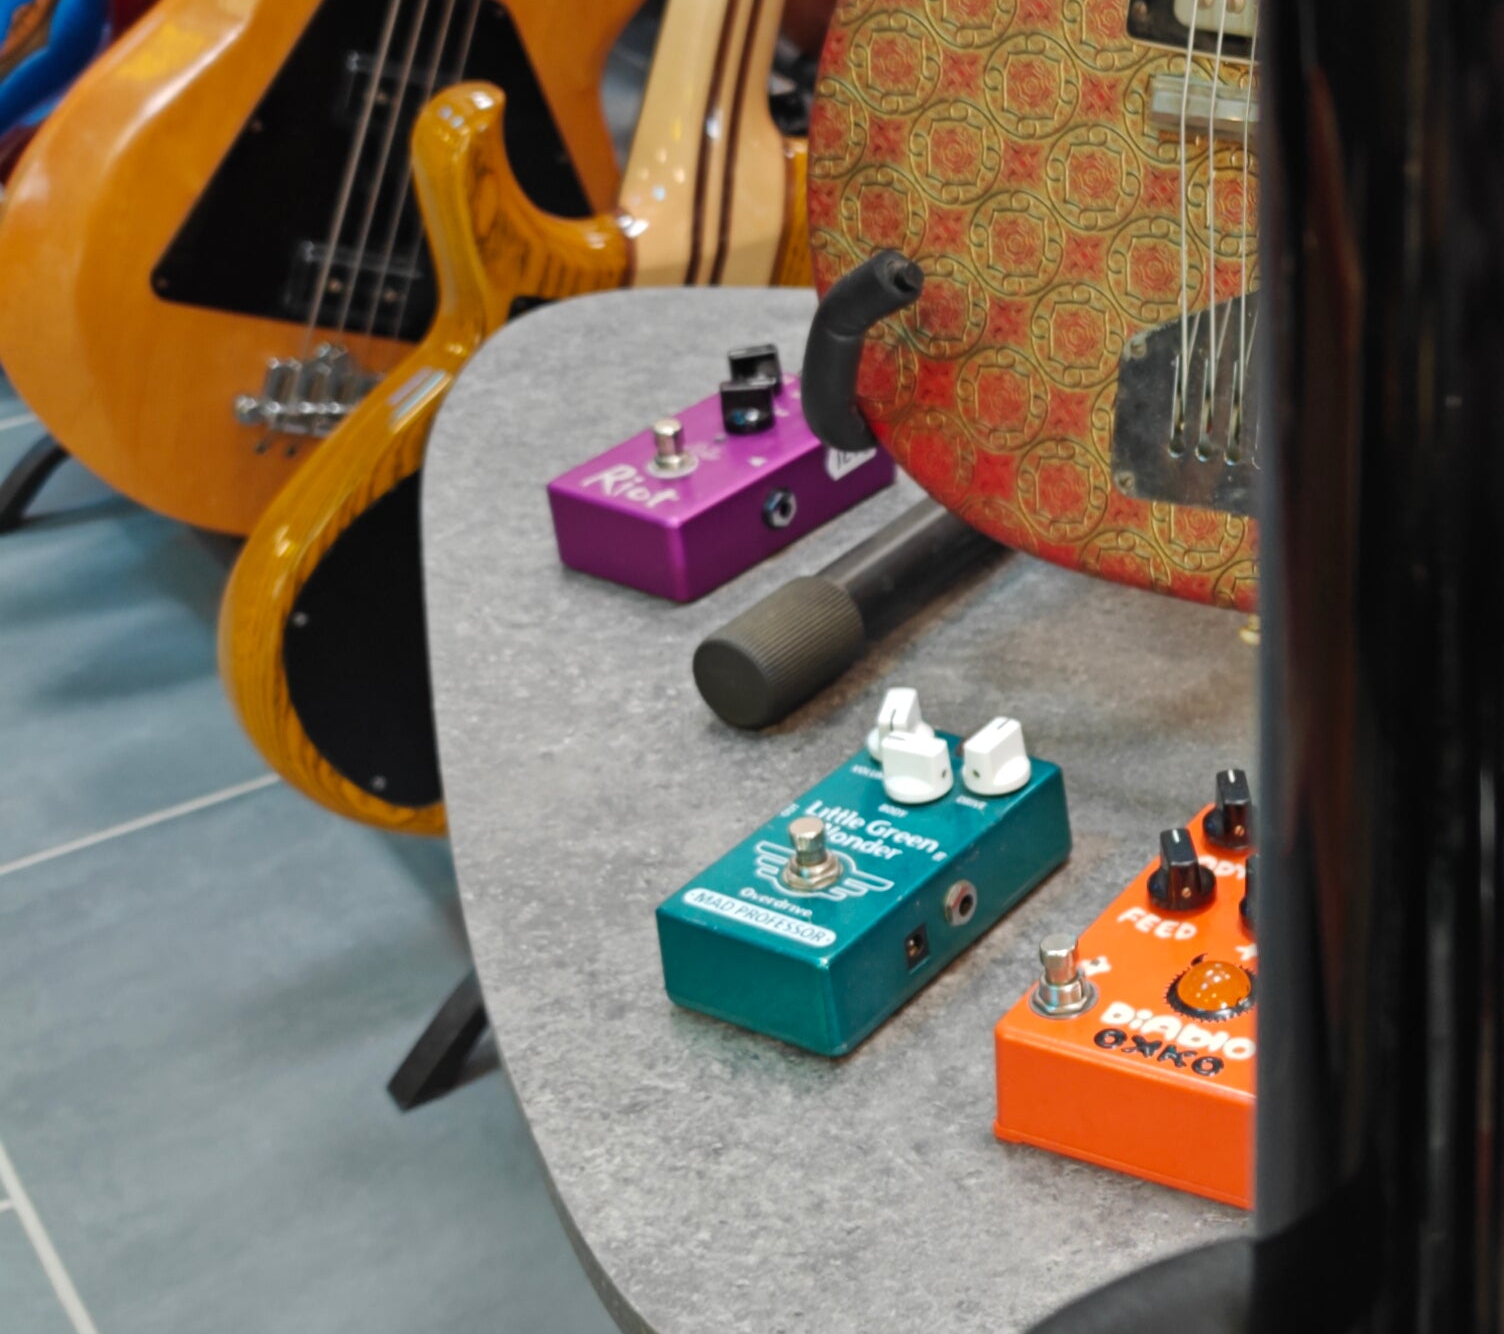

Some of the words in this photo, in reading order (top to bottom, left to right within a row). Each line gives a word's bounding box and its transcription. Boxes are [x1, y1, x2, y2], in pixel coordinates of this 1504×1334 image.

[580, 464, 681, 508] Riot
[804, 799, 866, 830] Little
[866, 819, 940, 854] Green
[693, 890, 735, 912] MAD
[734, 905, 827, 943] PROFESSOR
[739, 886, 813, 917] Overdrive
[1116, 906, 1198, 940] FEED
